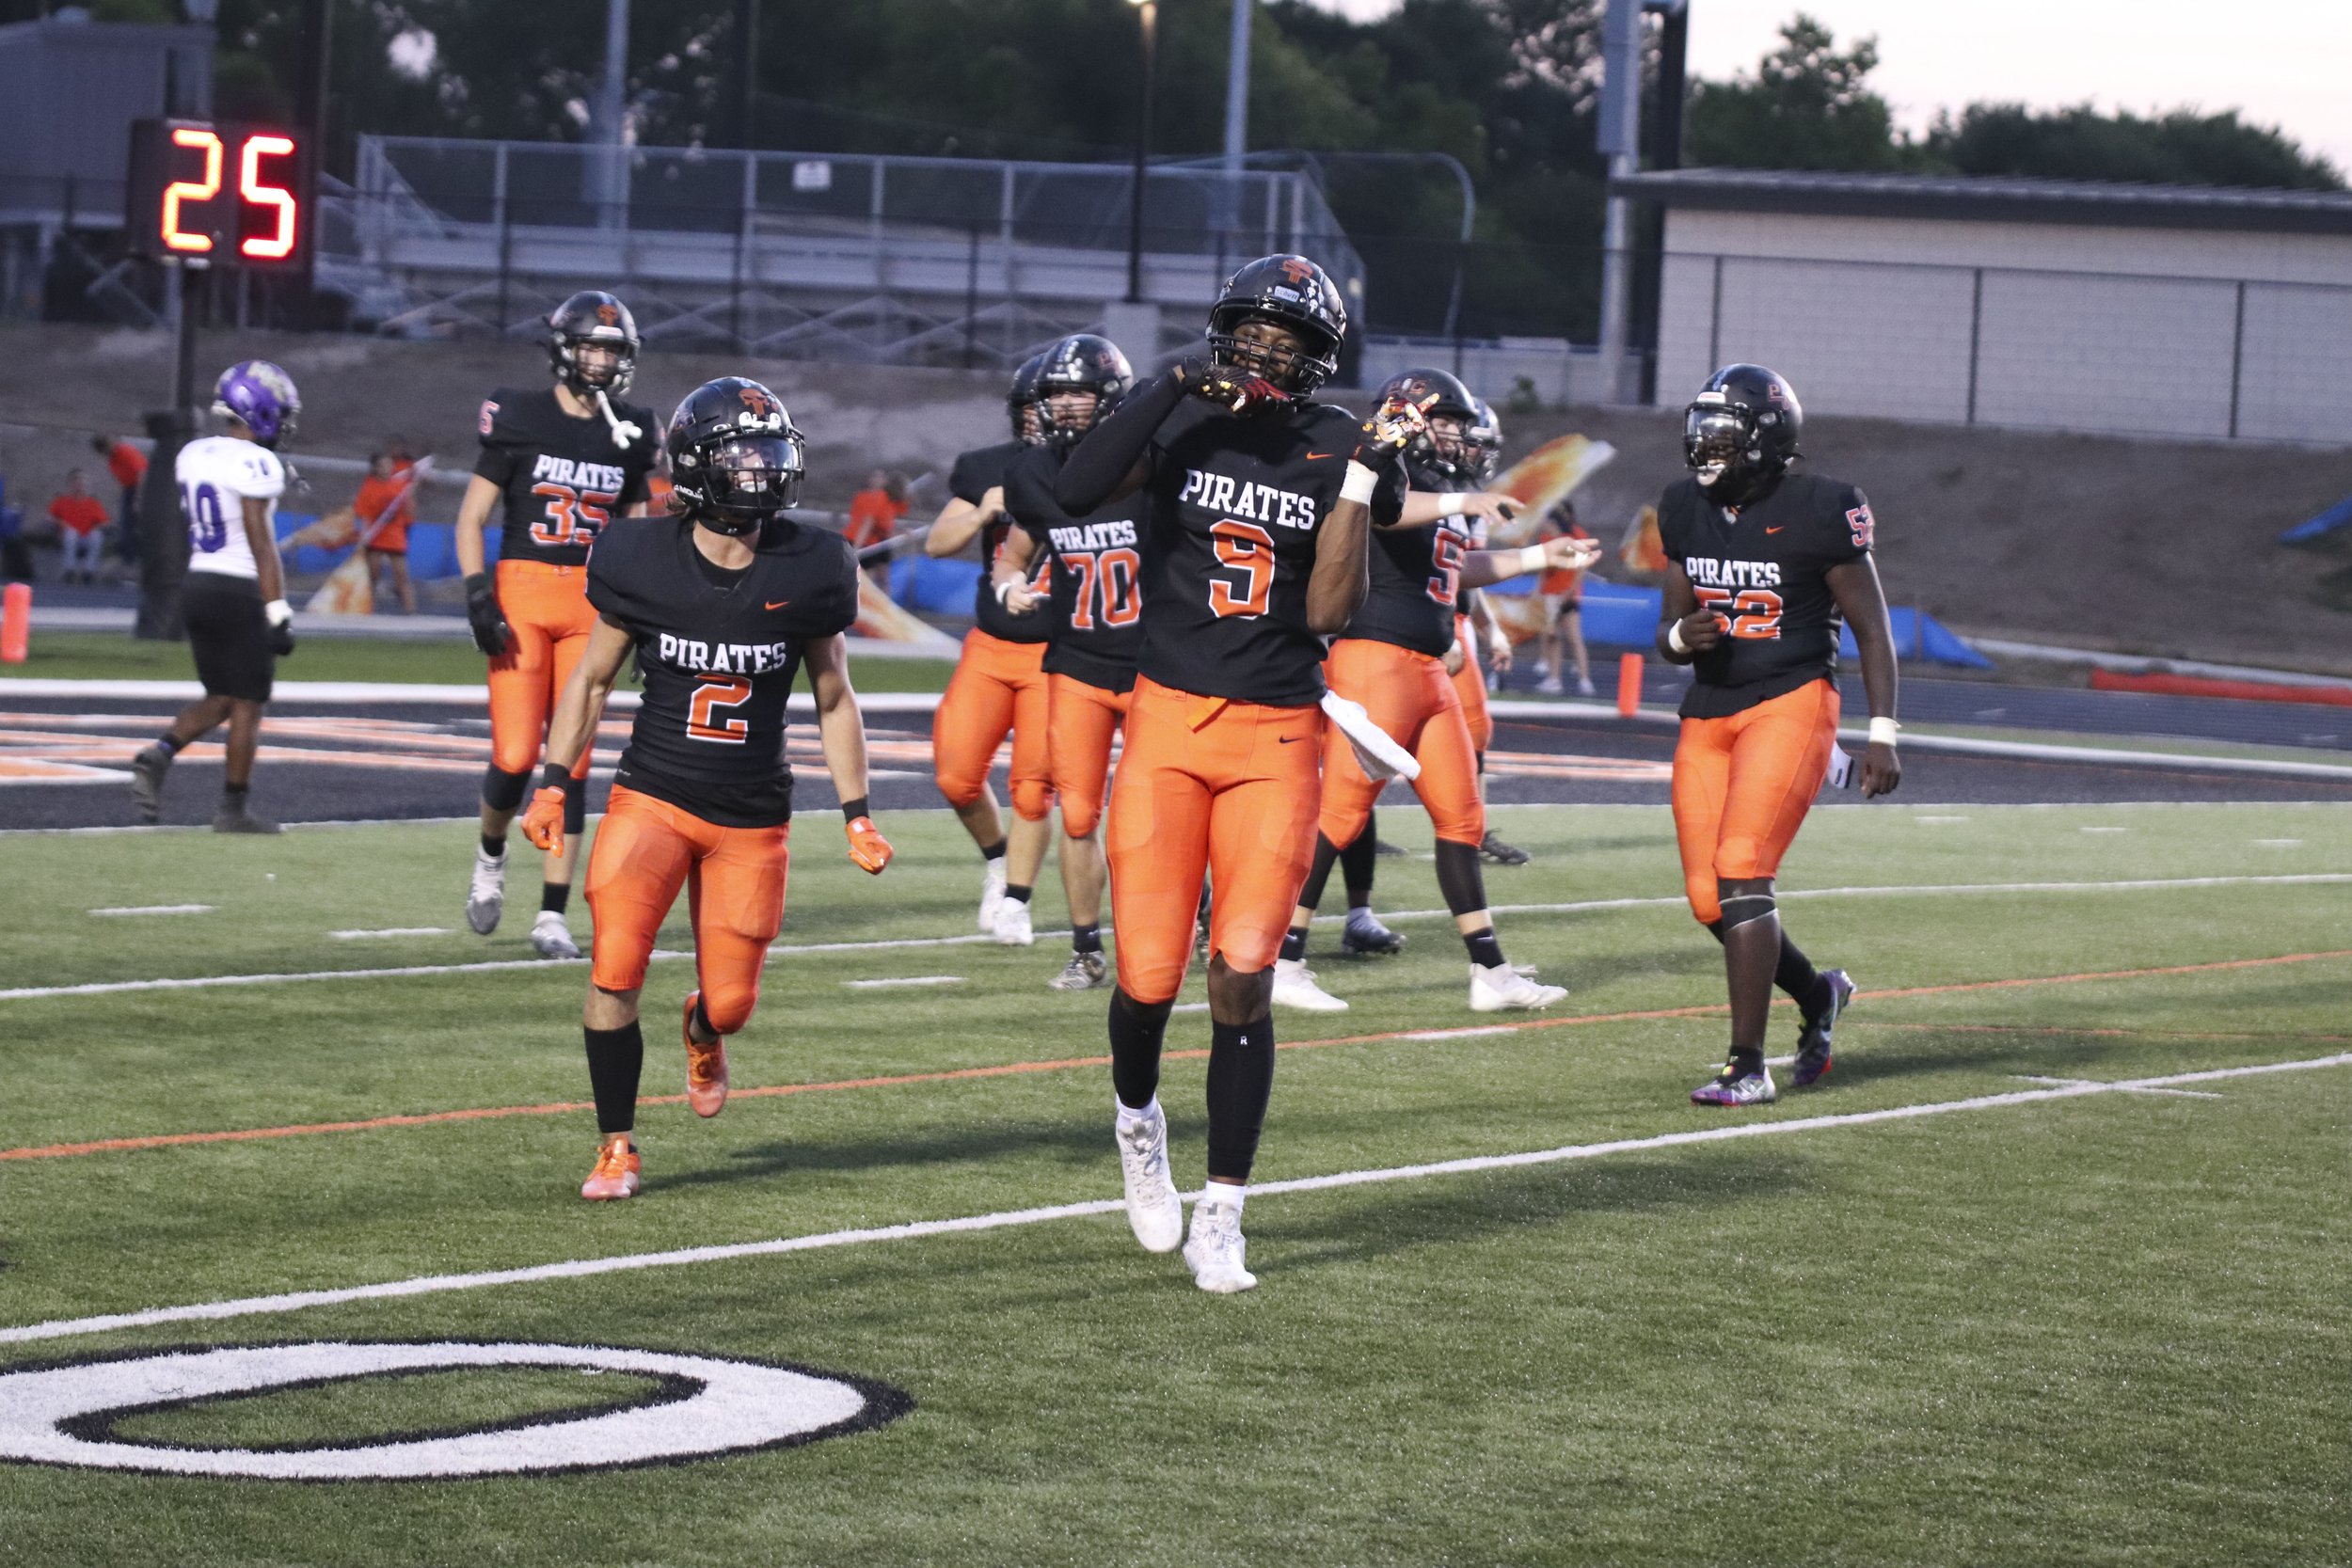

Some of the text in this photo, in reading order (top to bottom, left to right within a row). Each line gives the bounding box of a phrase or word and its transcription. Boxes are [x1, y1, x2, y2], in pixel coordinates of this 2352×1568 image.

[162, 129, 296, 257] 25
[532, 454, 625, 491] PIRATES
[1178, 468, 1315, 531] PIRATES
[530, 482, 619, 546] 35
[1049, 519, 1137, 552] PIRATES
[1059, 547, 1142, 629] 70
[1208, 518, 1275, 620] 9
[1686, 556, 1781, 587] PIRATES
[1694, 586, 1783, 640] 52
[660, 633, 787, 674] PIRATES
[687, 672, 753, 744] 2
